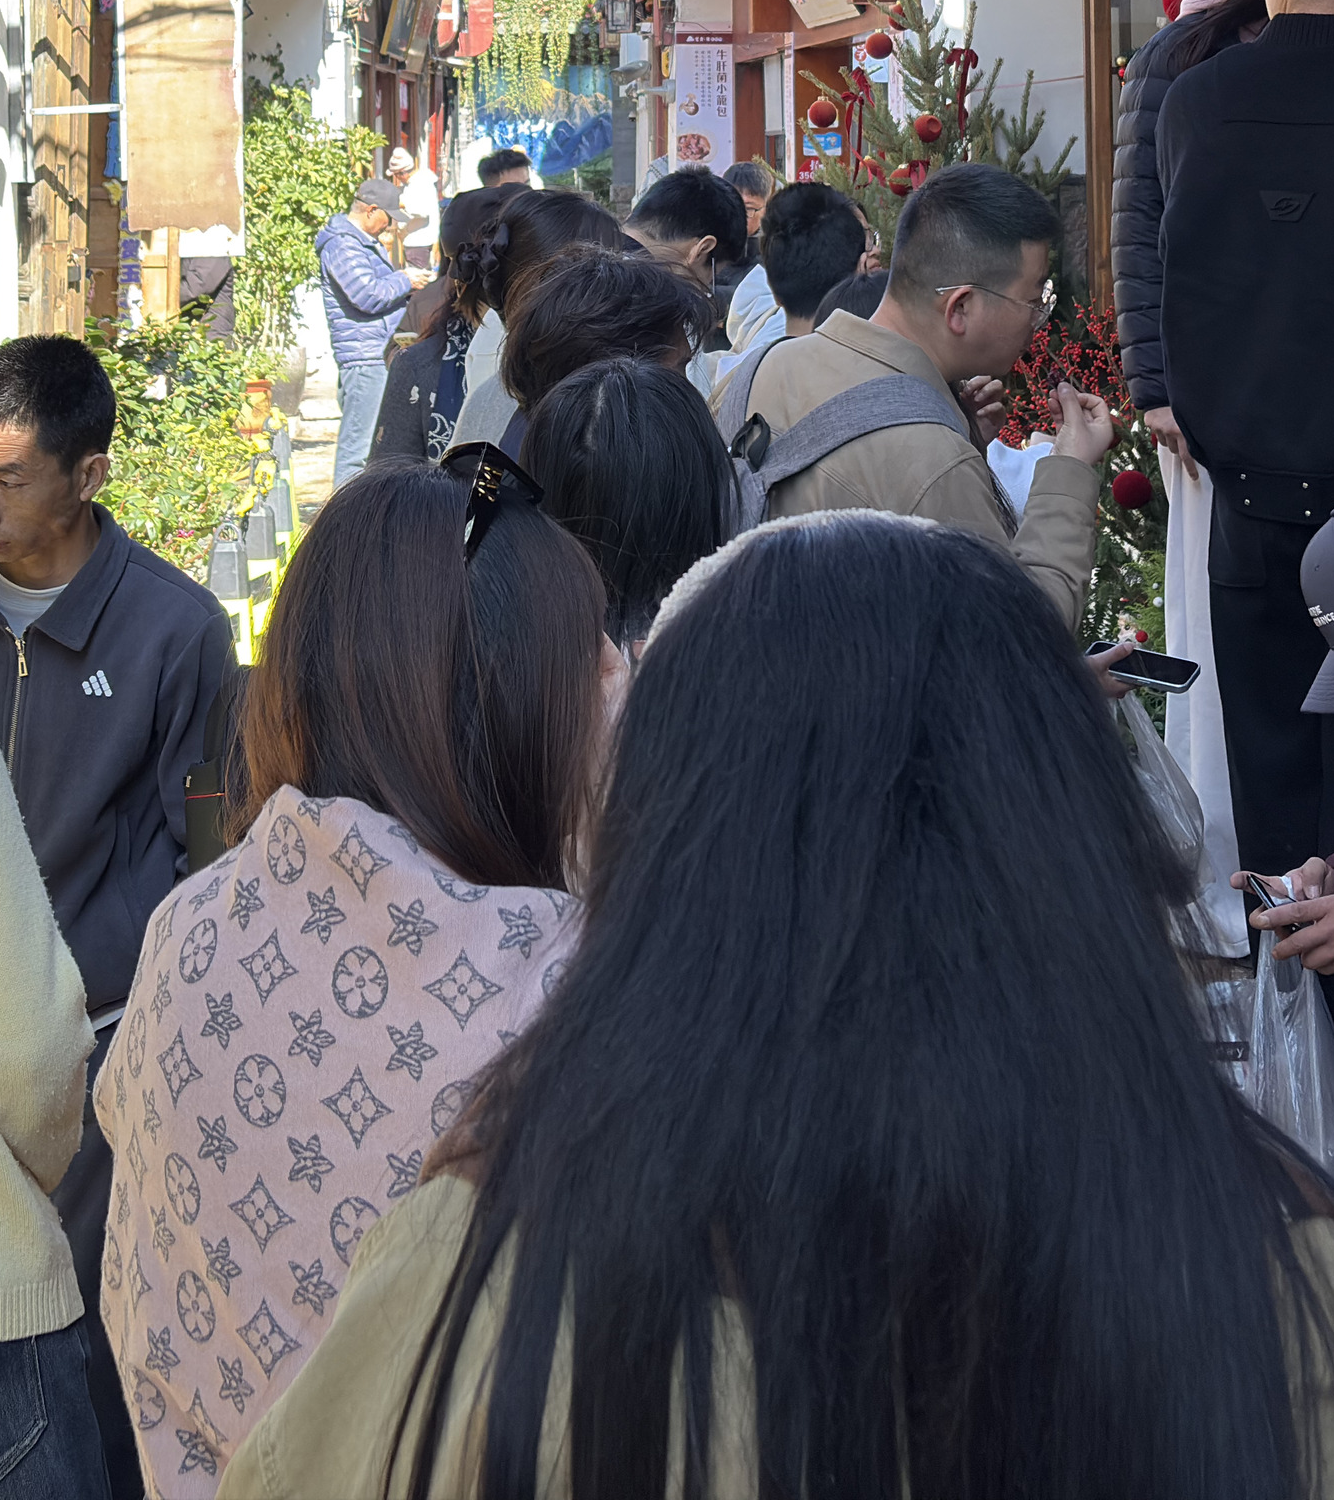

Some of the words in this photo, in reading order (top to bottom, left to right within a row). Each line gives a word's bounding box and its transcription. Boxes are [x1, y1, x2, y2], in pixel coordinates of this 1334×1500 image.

[716, 49, 727, 117] 牛肝菌小籠包
